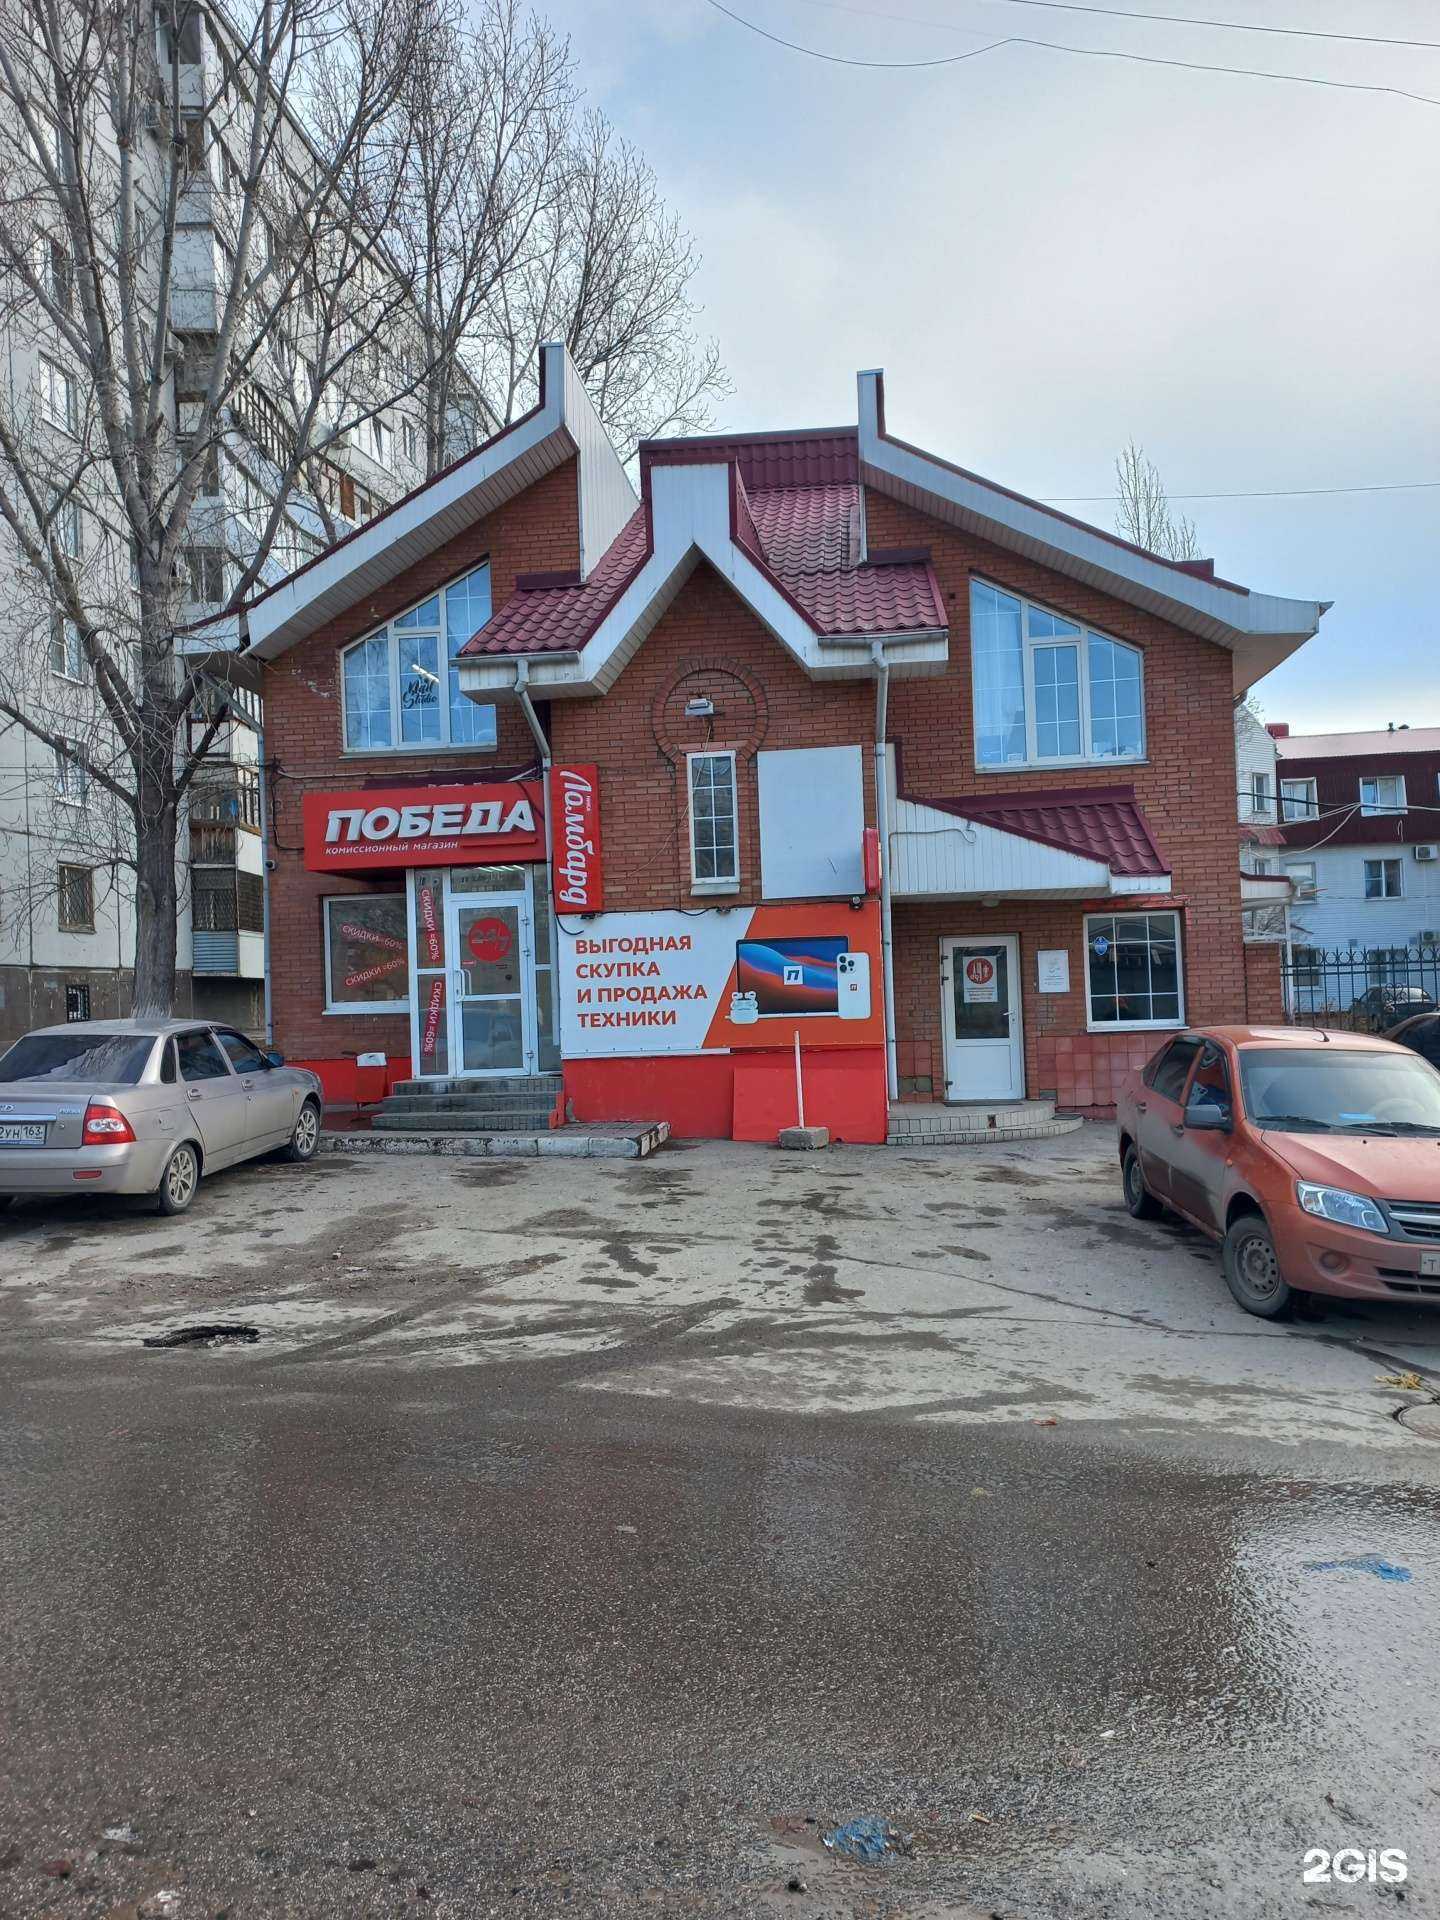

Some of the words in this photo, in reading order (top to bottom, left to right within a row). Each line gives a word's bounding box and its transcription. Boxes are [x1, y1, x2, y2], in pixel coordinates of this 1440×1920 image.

[325, 800, 536, 843] ПОБЕДА
[559, 770, 594, 905] Ломбард
[326, 842, 409, 855] комиссионный
[413, 841, 459, 850] магазин
[421, 889, 435, 932] СКИДКИ
[575, 935, 692, 955] ВЫГОДНАЯ
[575, 962, 661, 978] СКУПКА
[429, 982, 443, 1025] СКИДКИ
[577, 989, 591, 1003] И
[597, 985, 708, 1004] ПРОДАЖА
[577, 1010, 677, 1028] ТЕХНИКИ
